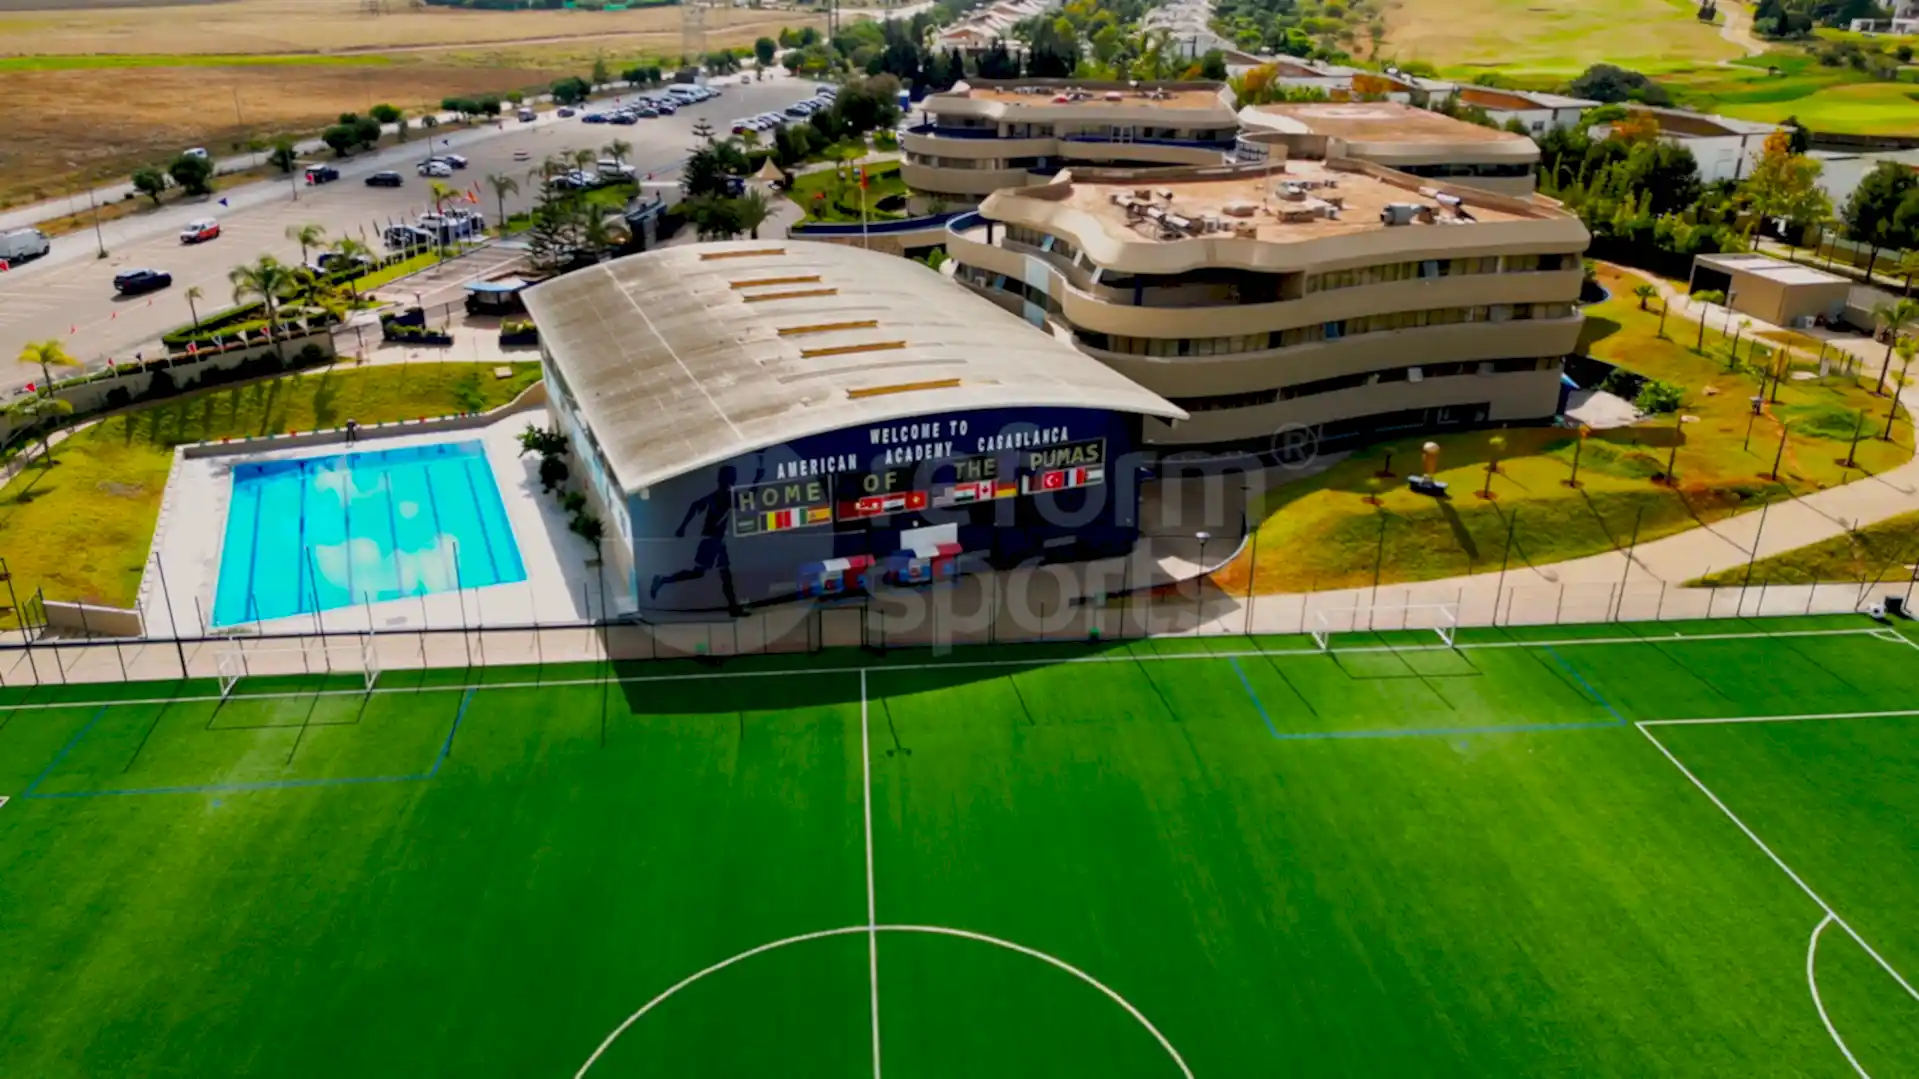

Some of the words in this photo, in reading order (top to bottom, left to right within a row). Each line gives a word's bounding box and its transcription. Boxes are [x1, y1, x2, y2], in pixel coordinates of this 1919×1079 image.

[776, 454, 858, 480] AMERICAN
[885, 441, 953, 465] ACADEMY
[977, 426, 1069, 452] CASABLANCA
[870, 422, 940, 445] WELCOME
[949, 420, 969, 437] TO
[738, 481, 821, 512] HOME
[863, 471, 898, 492] OF
[953, 458, 997, 480] THE
[1029, 443, 1100, 471] PUMAS
